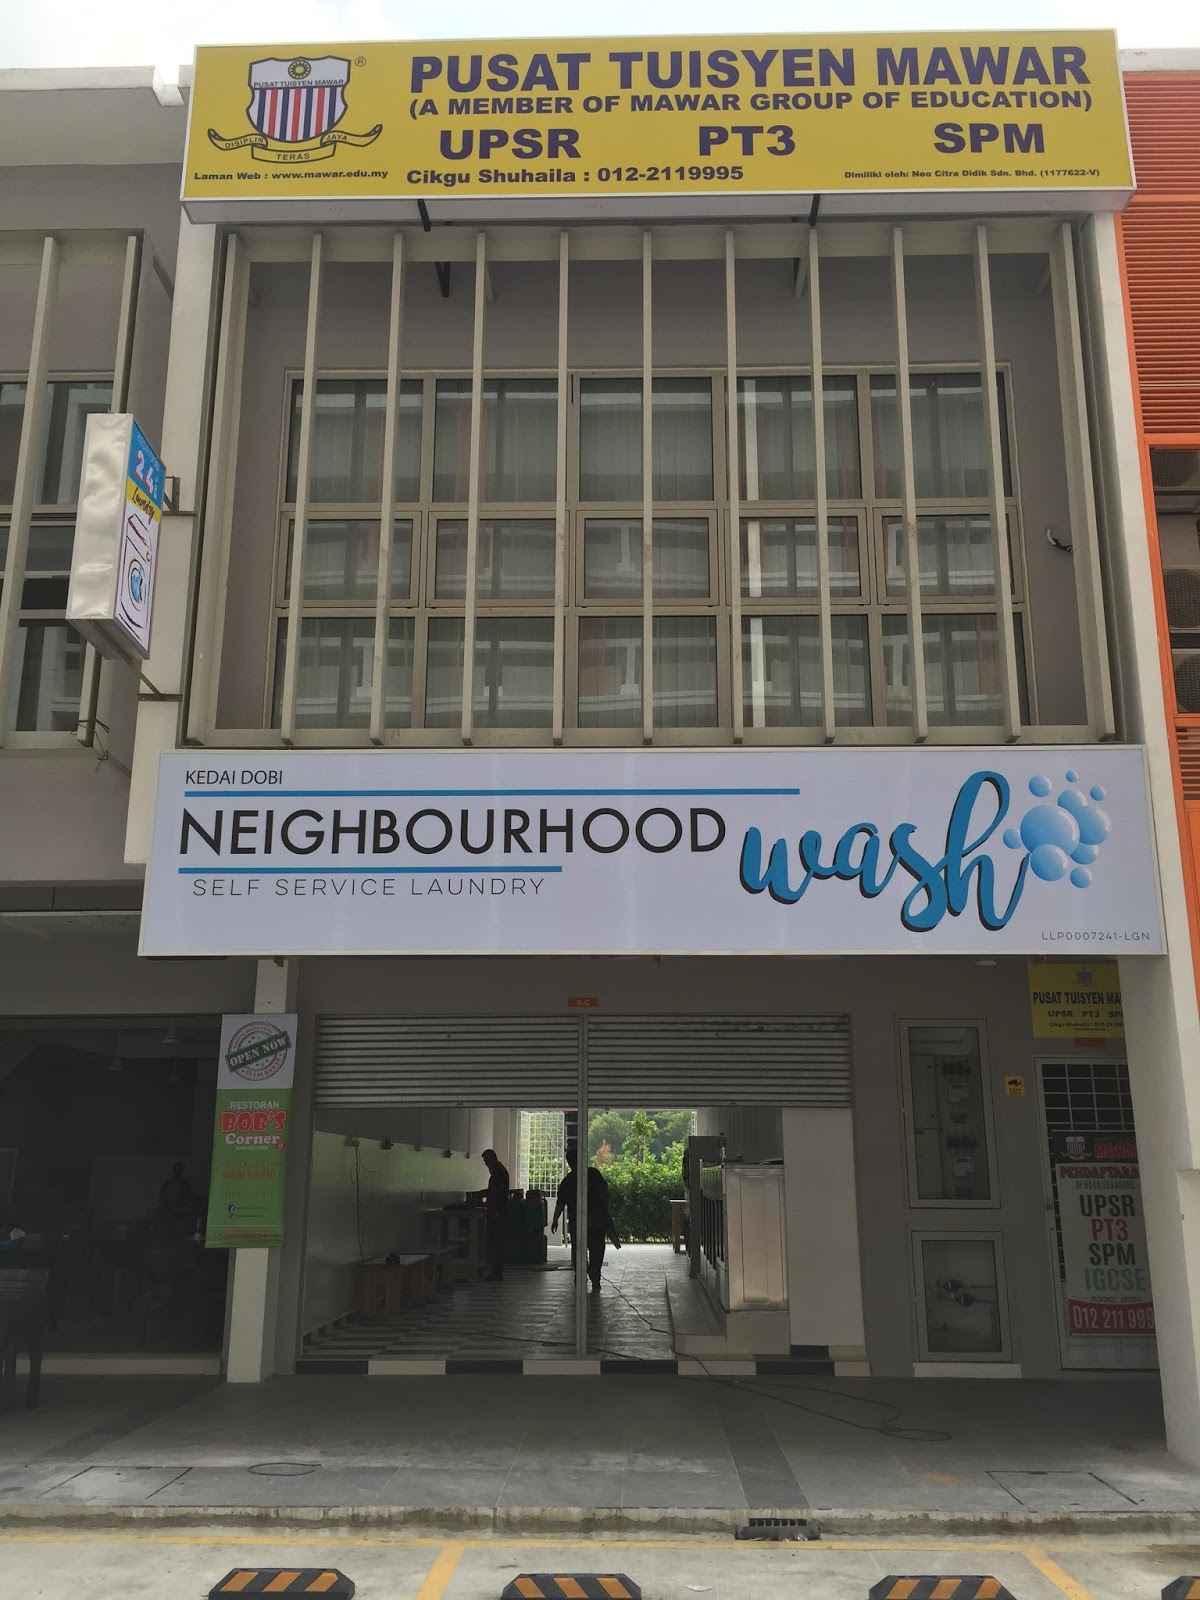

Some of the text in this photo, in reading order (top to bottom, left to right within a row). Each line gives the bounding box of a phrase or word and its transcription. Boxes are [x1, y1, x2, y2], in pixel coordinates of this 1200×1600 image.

[411, 46, 1092, 93] PUSAT TUISYEN MAWAR
[410, 90, 1092, 120] (A MEMBER OF MAWAR GROUP OF EDUCATION)
[224, 137, 264, 149] DISIPLIN
[440, 123, 1044, 160] UPSR PT3 SPM
[276, 152, 310, 161] TERAS
[194, 172, 232, 180] Laman
[237, 172, 261, 180] Web
[272, 169, 389, 180] www.mawar.edu.my
[407, 169, 471, 187] Cikgu
[479, 168, 575, 184] Shuhaila
[598, 166, 744, 182] 012-2119995
[845, 169, 1100, 179] Dimiliki oleh: Neo Citra Didik Sdn. Bhd. (1177622-V)
[135, 449, 154, 494] 24
[132, 486, 155, 525] Laundry
[186, 770, 283, 785] KEDAI DOBI
[180, 770, 1032, 933] NEIGHBOURHOOD wash
[193, 877, 545, 897] SELF SERVICE LAUNDRY
[1042, 931, 1150, 941] LLP0007241-LGN
[1033, 991, 1122, 1005] PUSAT TUISYEN MA
[229, 1047, 260, 1067] OPEN
[262, 1036, 287, 1054] NOW
[230, 1101, 280, 1110] RESTORAN
[221, 1110, 287, 1133] BOB'S
[225, 1133, 280, 1145] Corner
[1079, 1194, 1135, 1217] UPSR
[1091, 1219, 1128, 1241] PT3
[1089, 1242, 1136, 1265] SPM
[1084, 1268, 1147, 1292] IGCSE
[1073, 1305, 1098, 1329] 012
[1103, 1308, 1125, 1329] 211
